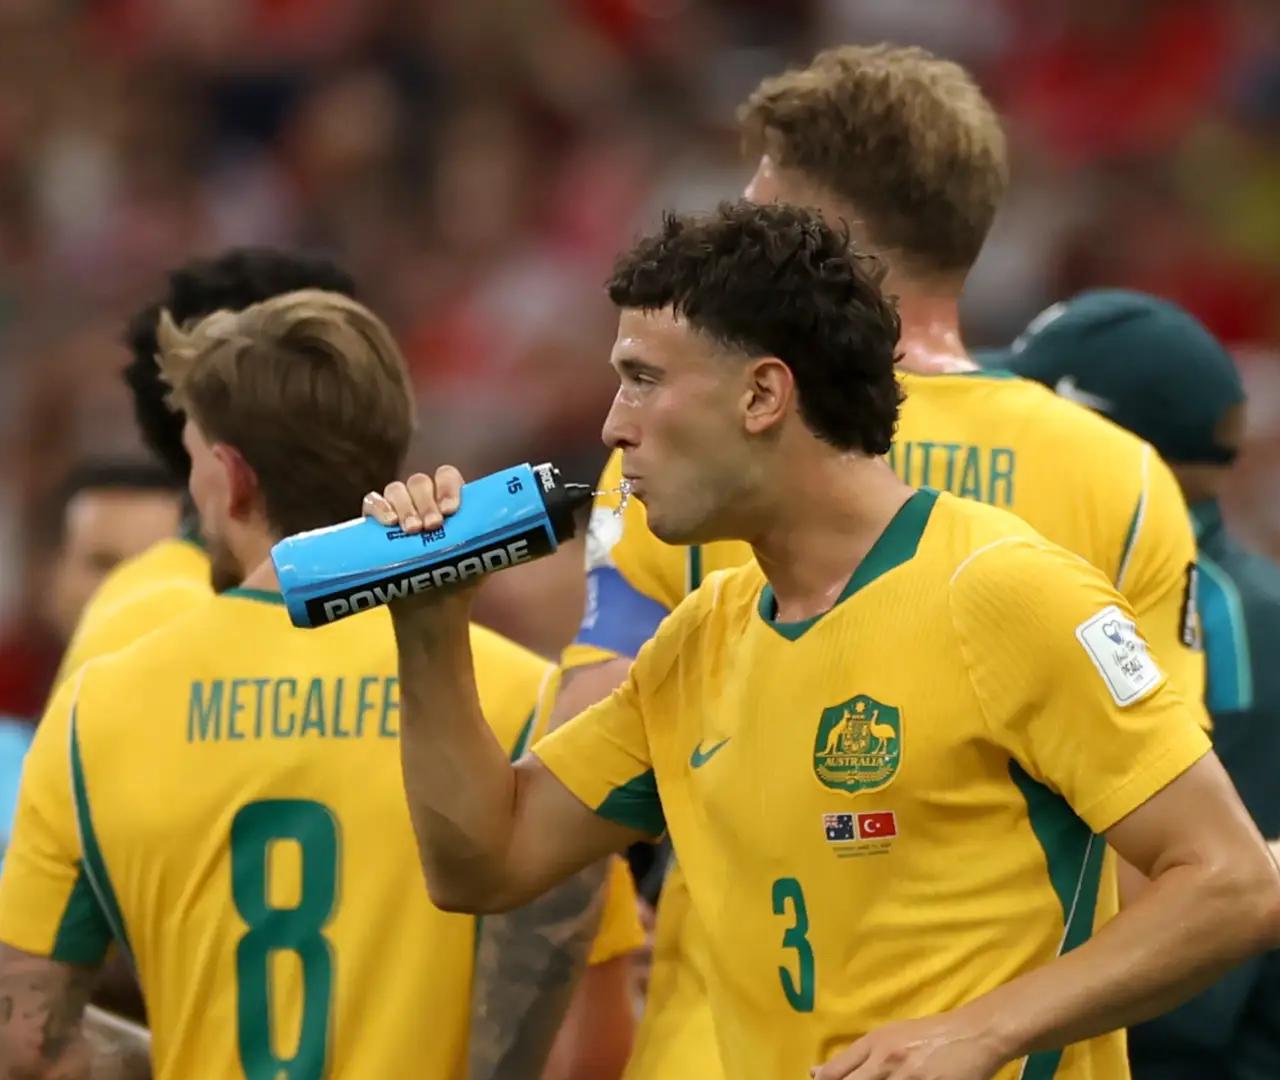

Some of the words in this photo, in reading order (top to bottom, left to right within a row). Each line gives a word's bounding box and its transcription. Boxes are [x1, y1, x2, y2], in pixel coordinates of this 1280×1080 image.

[506, 476, 523, 494] 15
[887, 441, 1015, 507] UTTAR
[323, 539, 530, 622] POWERADE
[186, 677, 400, 742] METCALFE
[824, 756, 884, 767] AUSTRALIA
[772, 877, 815, 1013] 3
